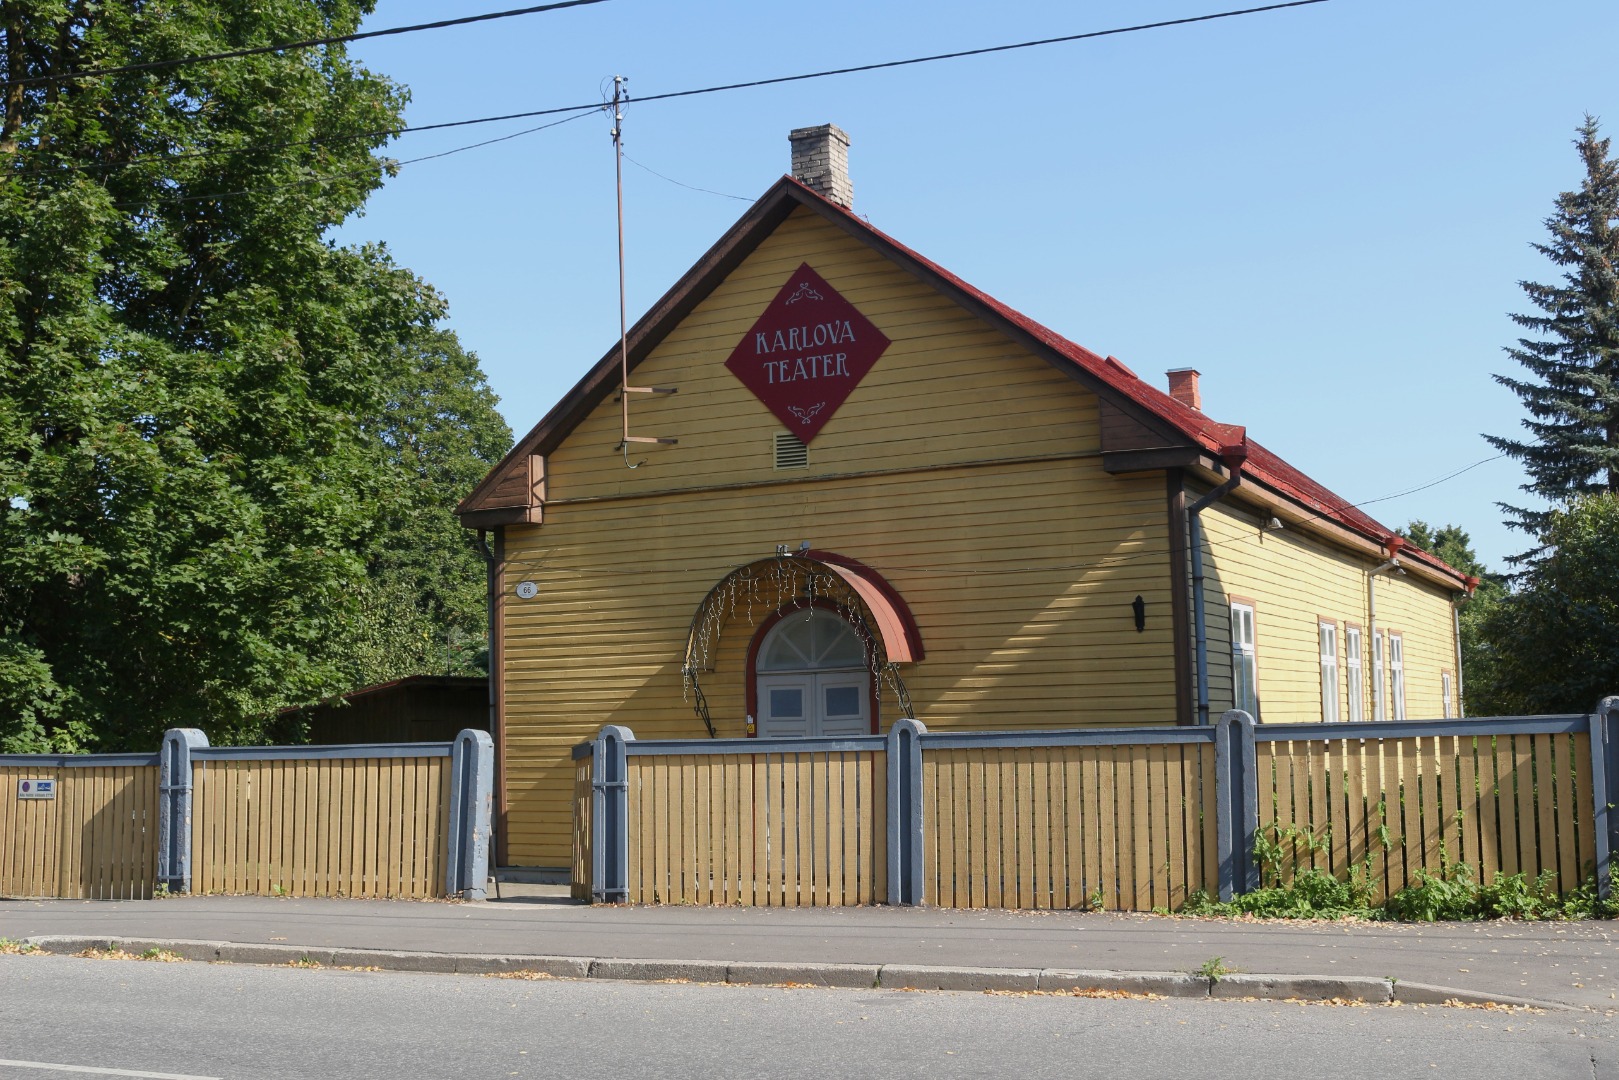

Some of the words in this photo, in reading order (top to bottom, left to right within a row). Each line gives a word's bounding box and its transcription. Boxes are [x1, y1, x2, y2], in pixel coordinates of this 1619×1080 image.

[755, 319, 856, 354] KARLOVA
[762, 352, 850, 384] TEATER
[523, 586, 532, 594] 66
